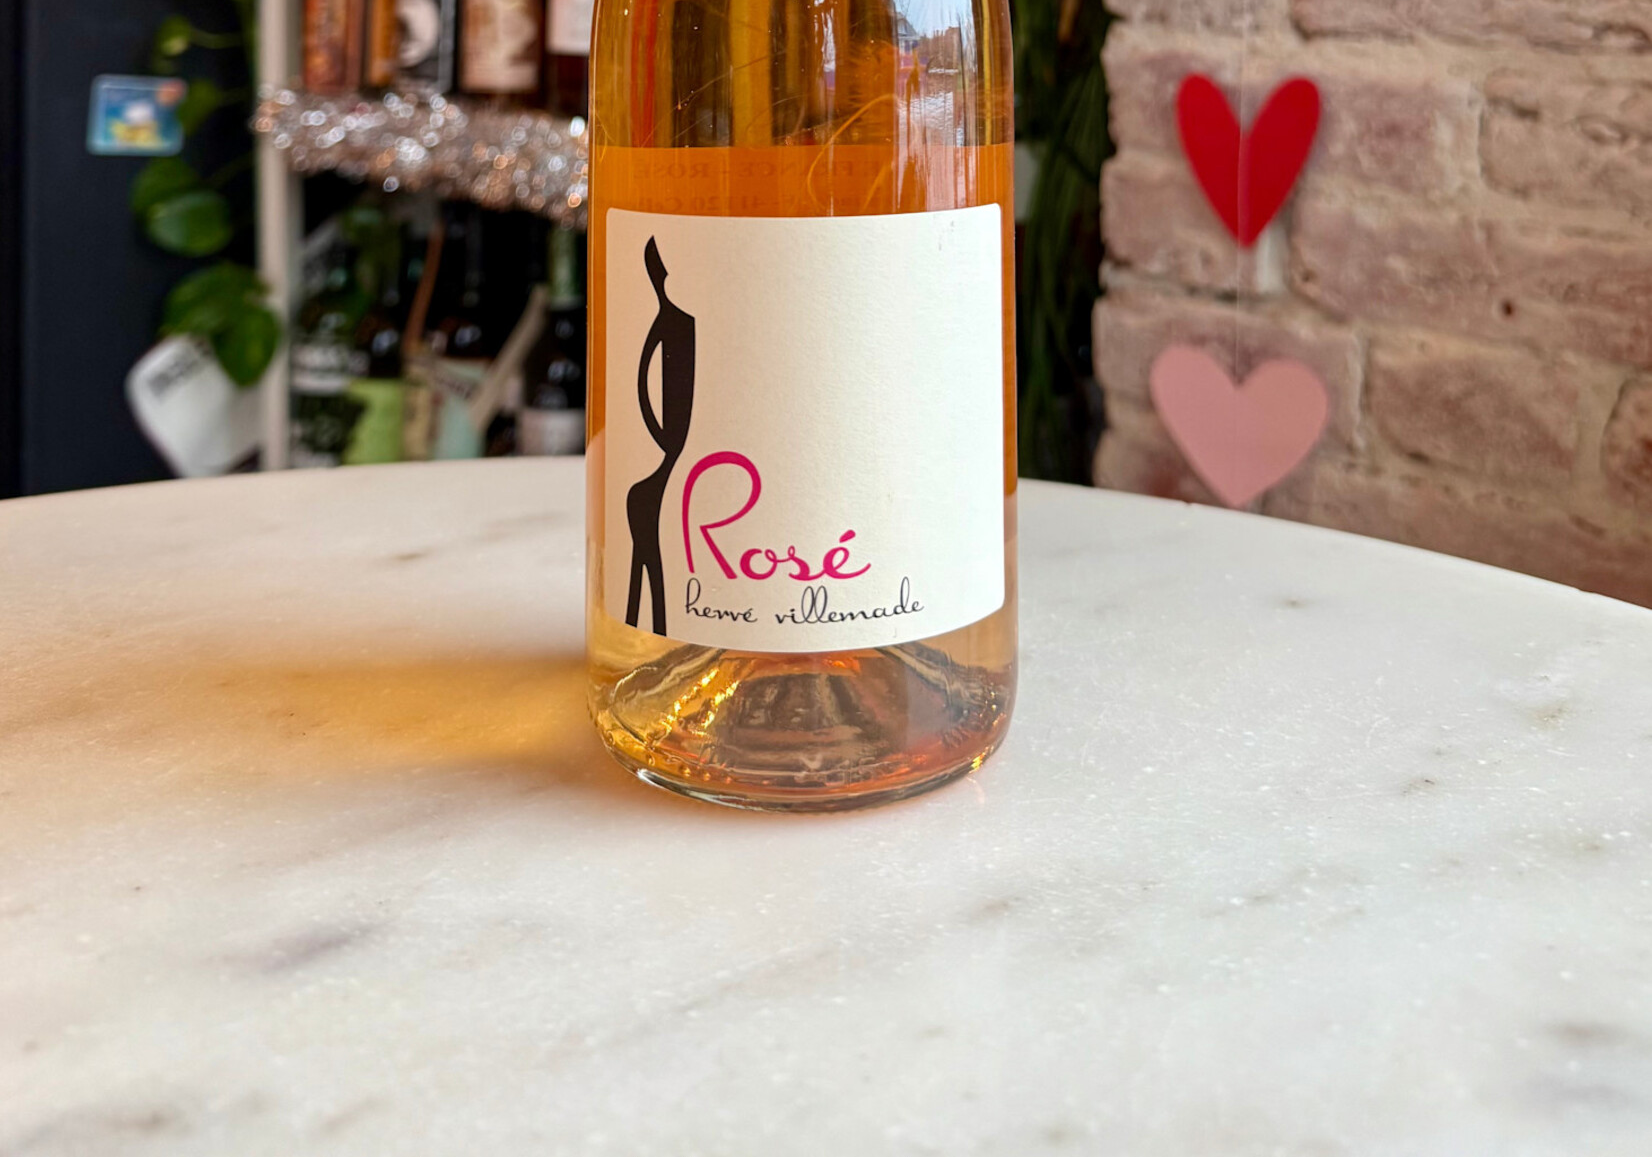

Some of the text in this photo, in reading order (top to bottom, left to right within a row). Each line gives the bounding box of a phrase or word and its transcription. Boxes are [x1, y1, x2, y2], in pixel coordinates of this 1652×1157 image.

[682, 451, 871, 580] Rosé
[685, 576, 925, 624] hervé villemade
